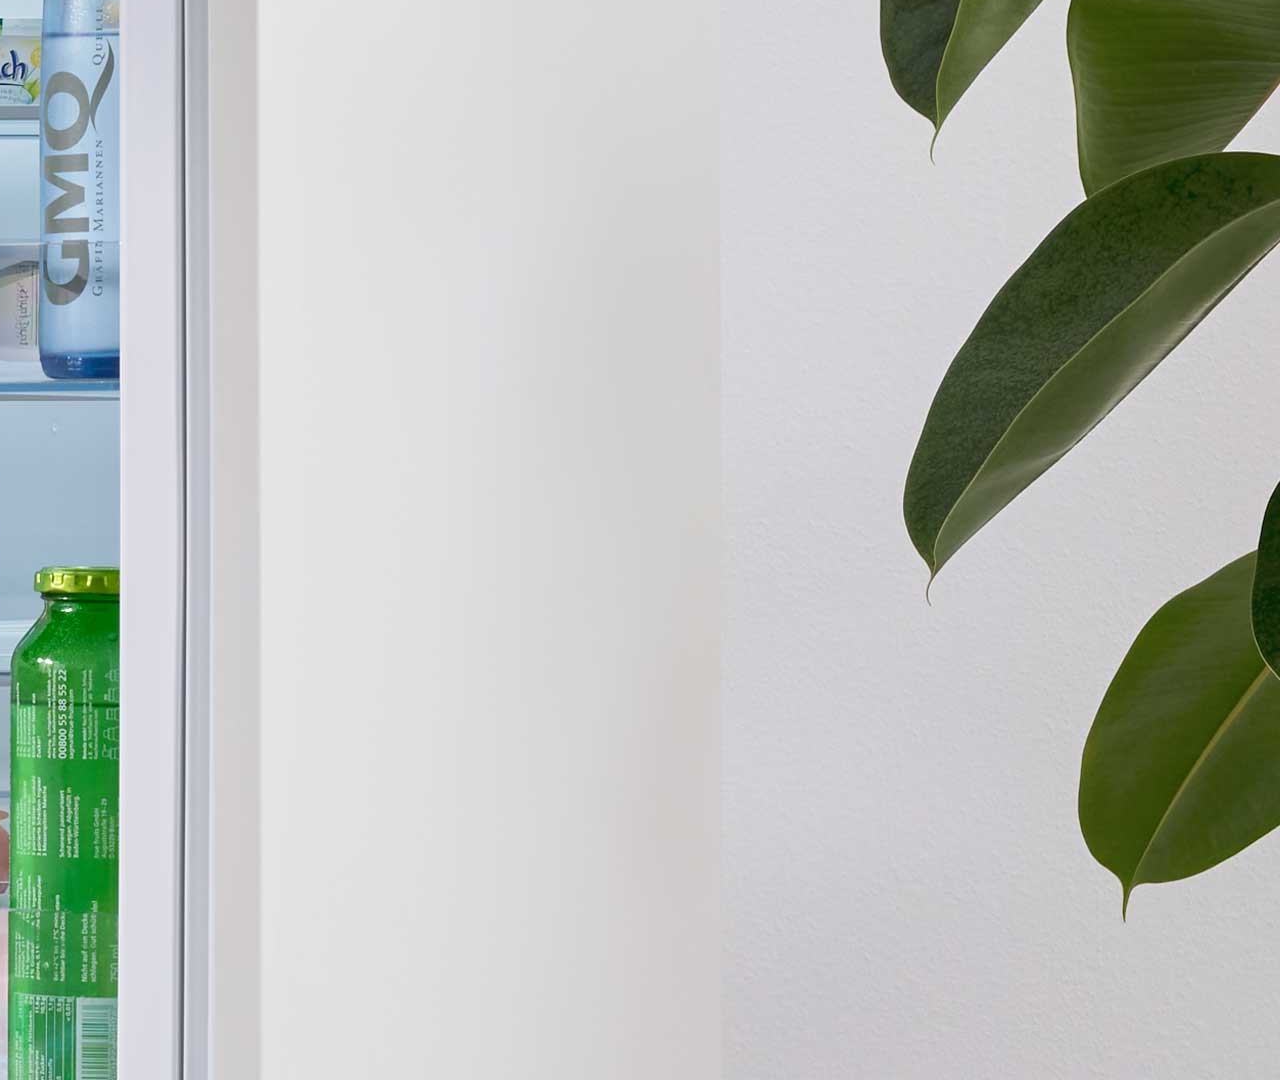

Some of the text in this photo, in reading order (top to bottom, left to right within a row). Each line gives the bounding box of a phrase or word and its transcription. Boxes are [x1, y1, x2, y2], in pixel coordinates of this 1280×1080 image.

[42, 39, 115, 306] GMQ
[58, 669, 67, 759] 00800 55 88 55 22
